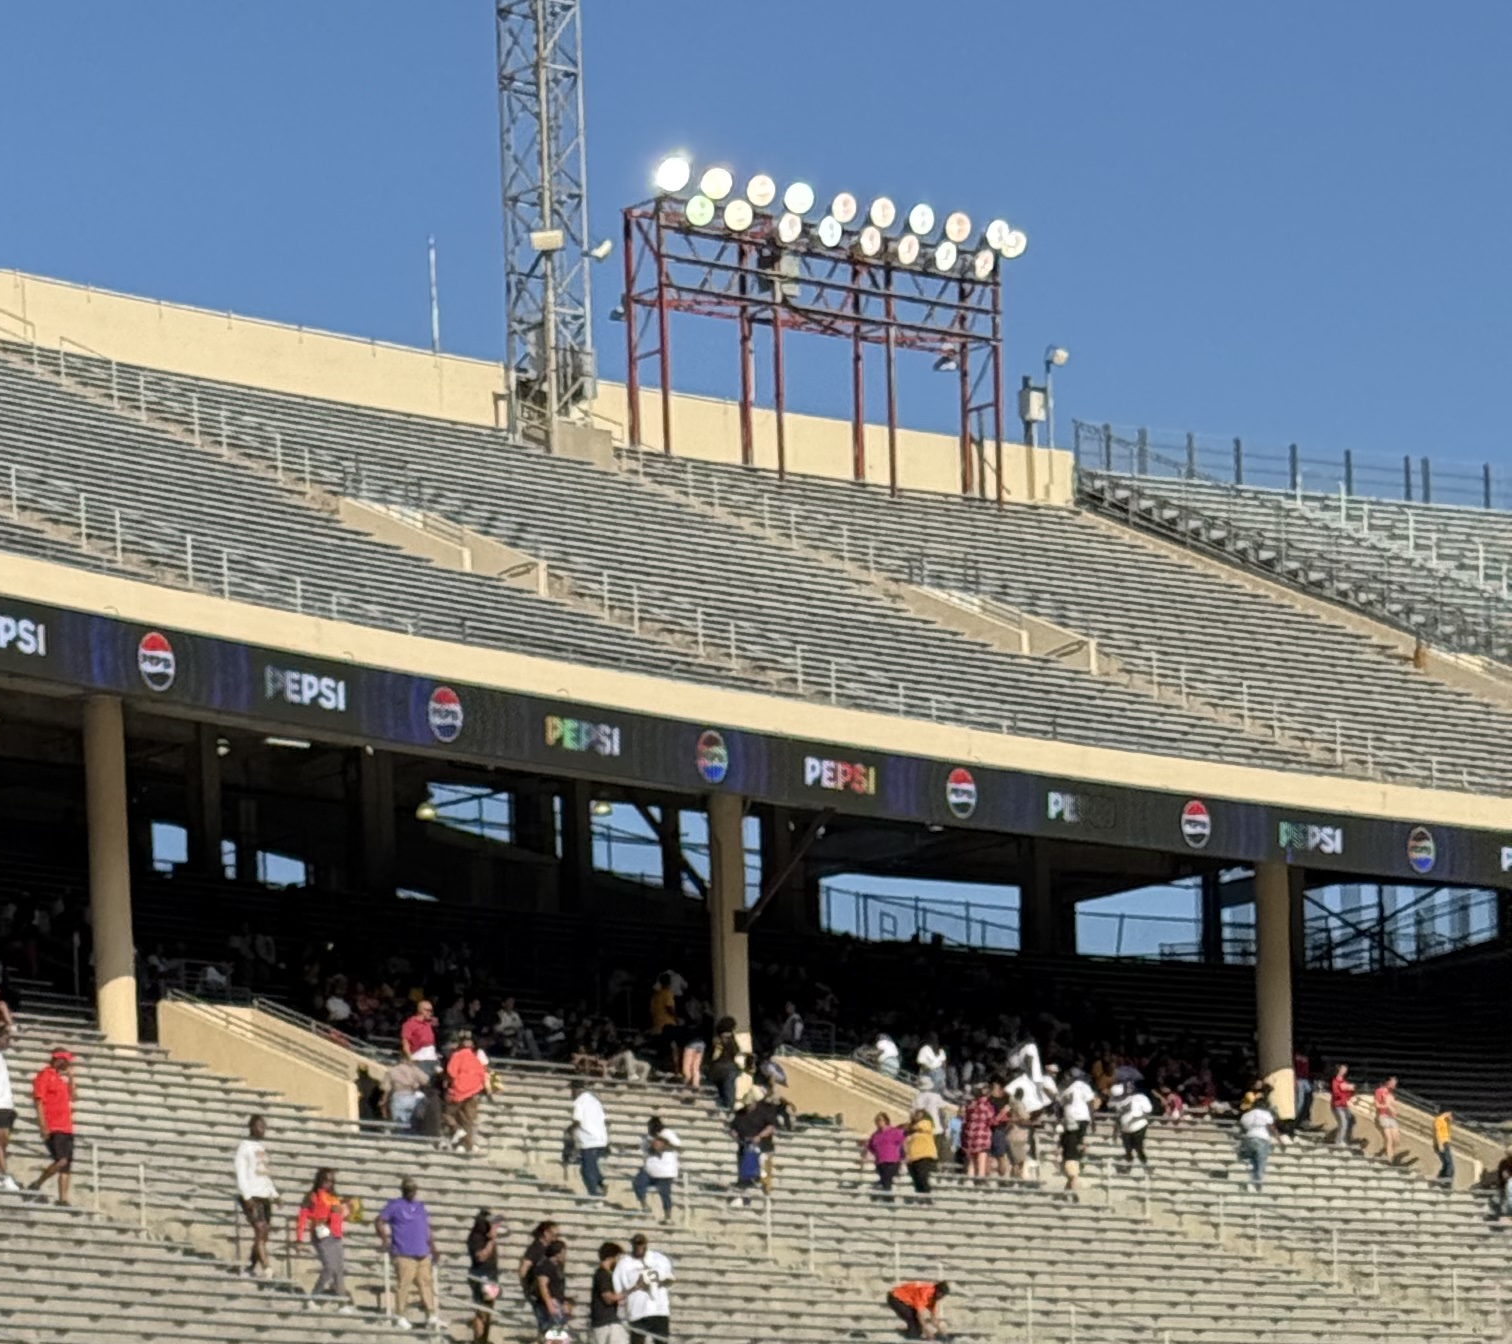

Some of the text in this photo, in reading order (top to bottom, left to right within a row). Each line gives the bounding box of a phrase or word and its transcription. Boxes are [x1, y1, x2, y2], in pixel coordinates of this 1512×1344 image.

[265, 665, 347, 712] PEPSI
[544, 715, 621, 757] PEPSI
[804, 756, 876, 795] PEPSI
